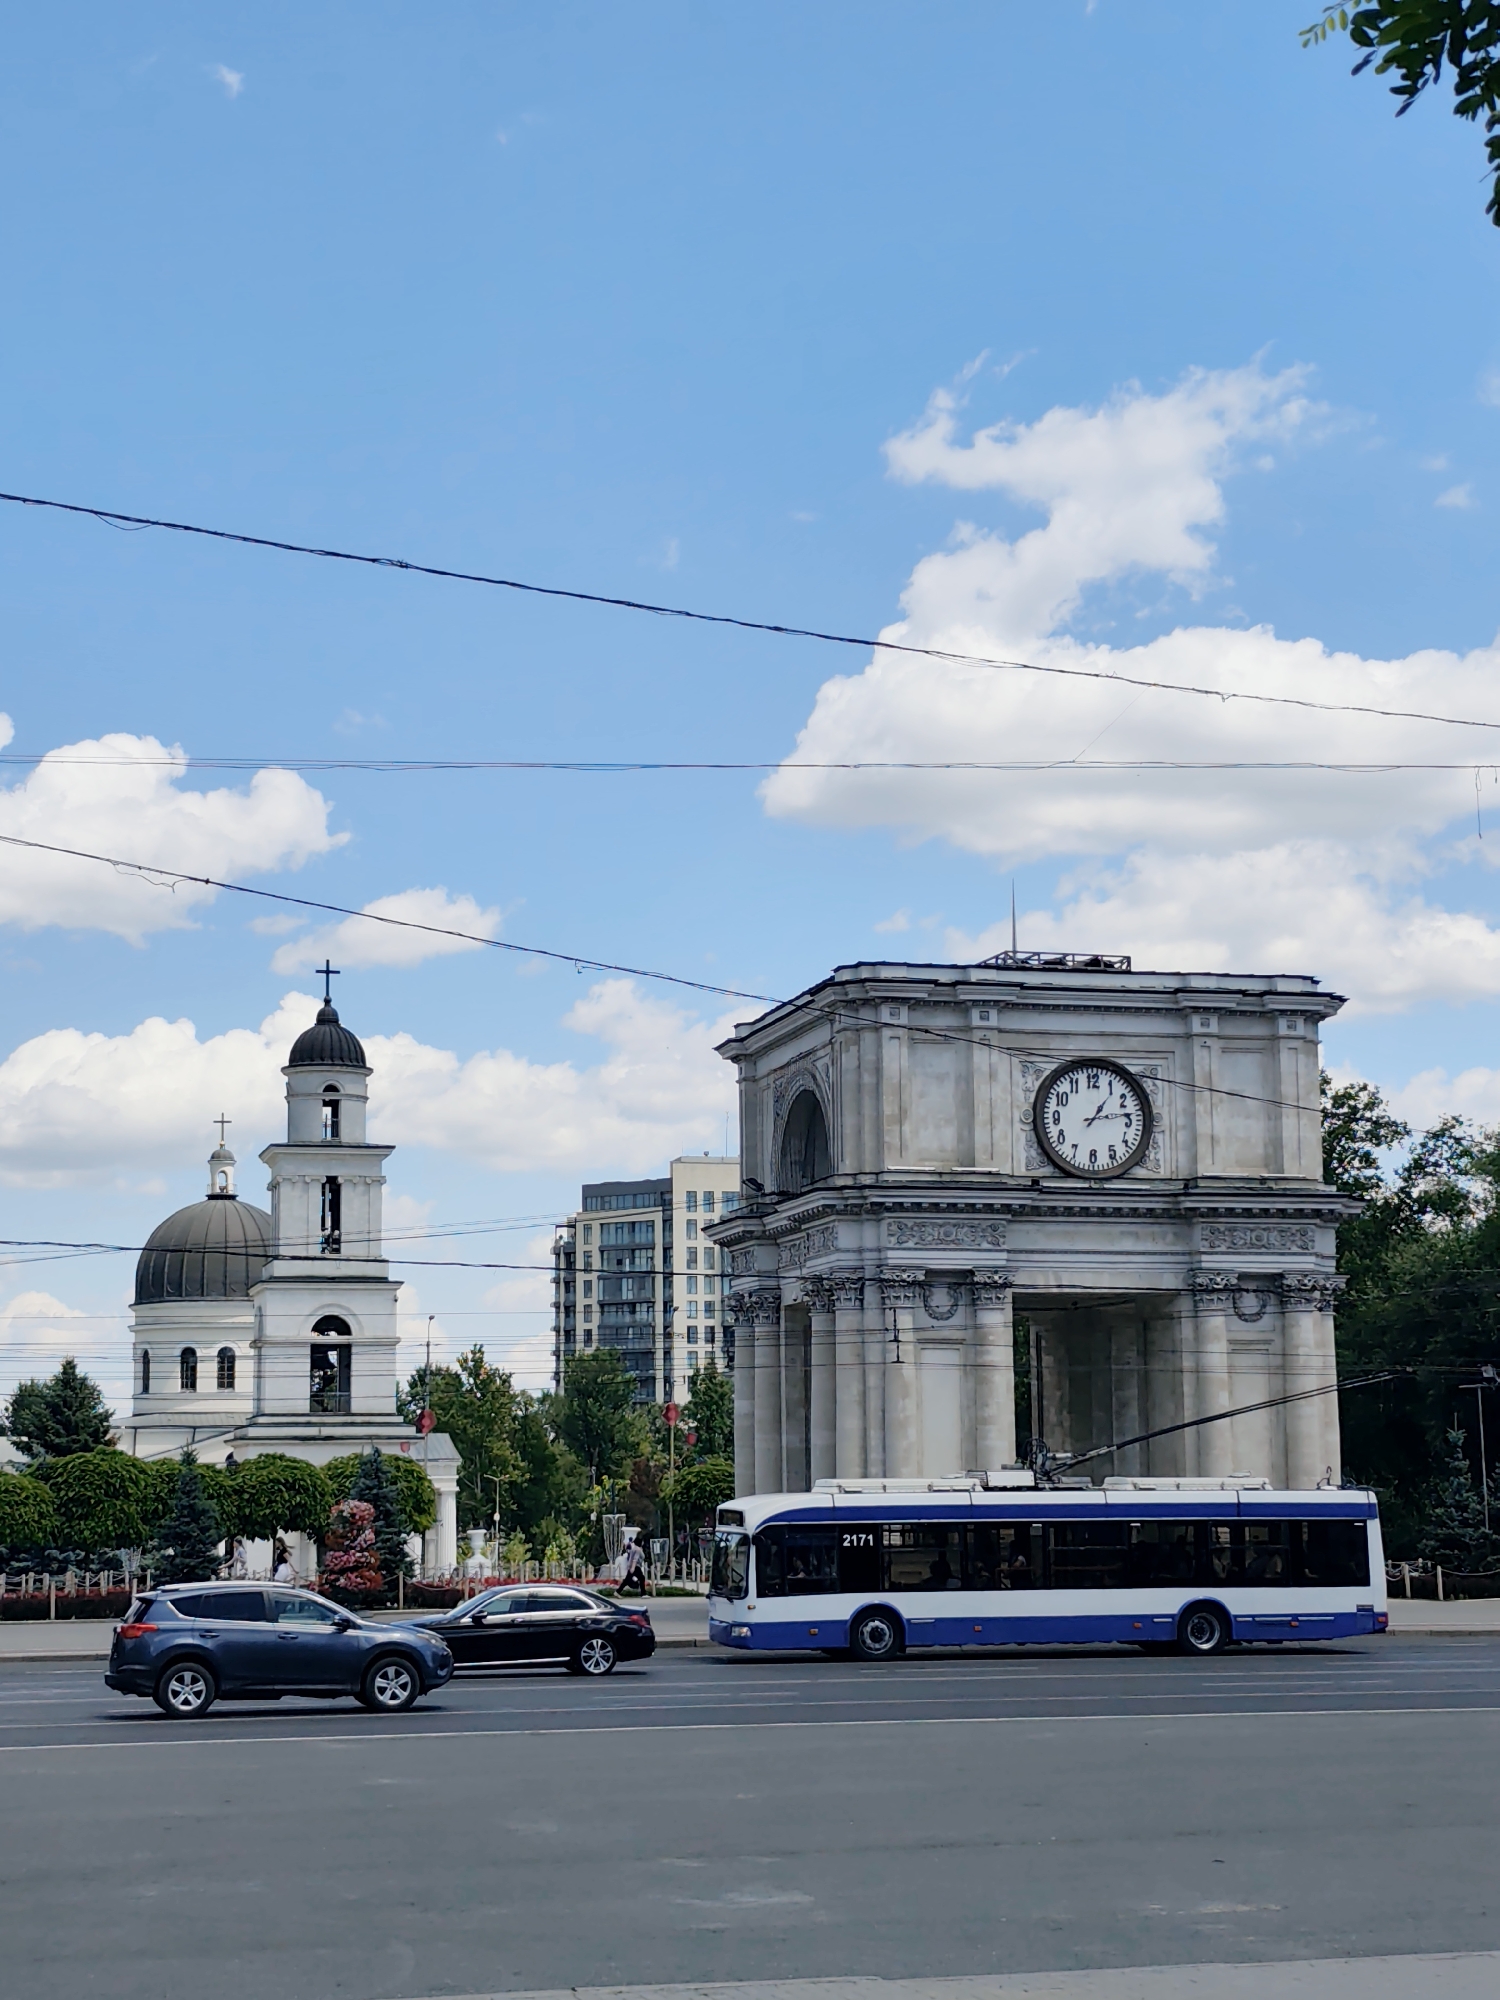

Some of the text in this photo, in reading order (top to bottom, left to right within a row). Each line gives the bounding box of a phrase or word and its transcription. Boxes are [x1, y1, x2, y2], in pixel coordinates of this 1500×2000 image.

[1069, 1078, 1078, 1094] 11
[1086, 1074, 1100, 1089] 12
[1108, 1080, 1113, 1096] 1
[1056, 1091, 1068, 1107] 10
[1120, 1094, 1127, 1108] 2
[1052, 1110, 1060, 1126] 9
[1124, 1113, 1132, 1128] 3
[1057, 1129, 1065, 1145] 8
[1122, 1132, 1130, 1148] 4
[1071, 1143, 1079, 1159] 7
[1090, 1149, 1097, 1164] 6
[1108, 1145, 1116, 1160] 5
[843, 1534, 873, 1546] 2171
